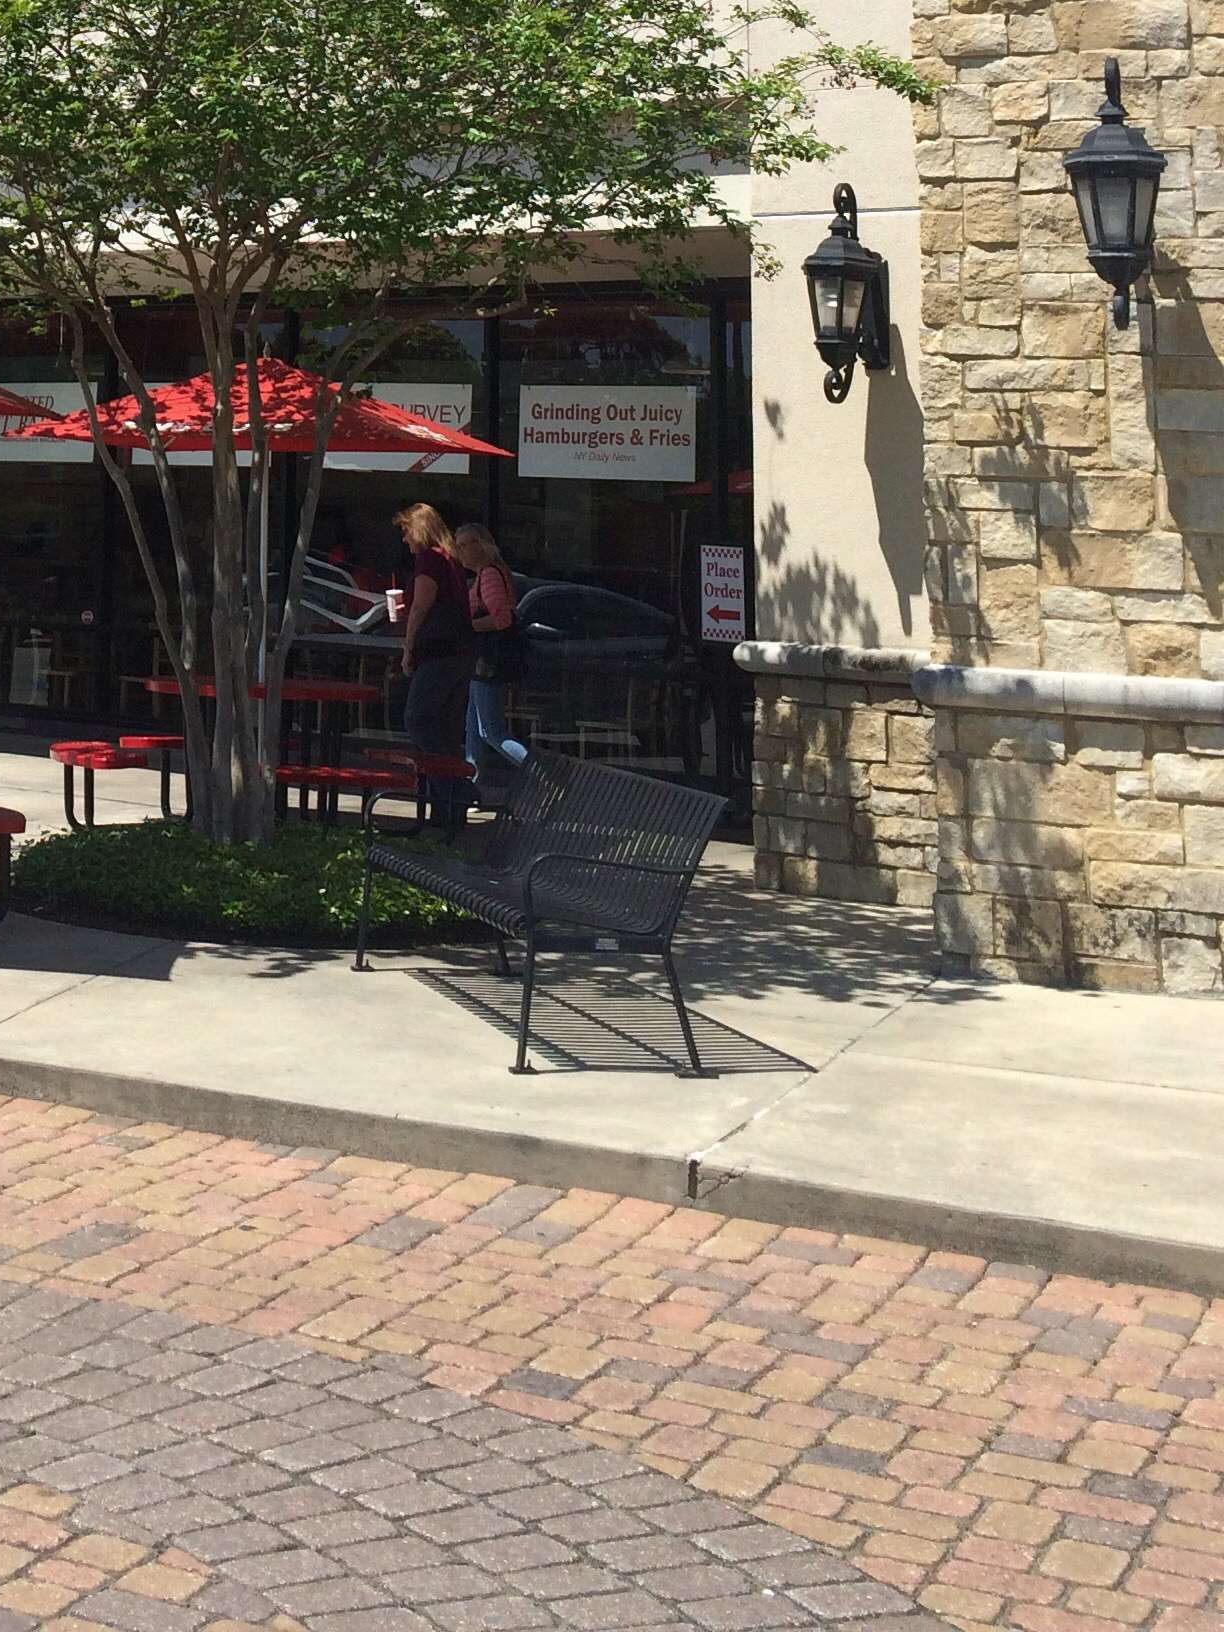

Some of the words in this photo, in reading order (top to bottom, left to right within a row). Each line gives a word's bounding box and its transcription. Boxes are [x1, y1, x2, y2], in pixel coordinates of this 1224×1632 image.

[391, 403, 466, 424] RVEY
[531, 403, 602, 425] Grinding
[606, 404, 636, 421] Out
[640, 404, 682, 426] Juicy
[523, 427, 625, 449] Hamburgers
[630, 428, 644, 446] &
[649, 429, 690, 447] Fries
[574, 451, 585, 461] NY
[588, 451, 610, 464] Daily
[612, 453, 636, 463] News
[705, 562, 741, 579] Place
[704, 582, 743, 599] Order
